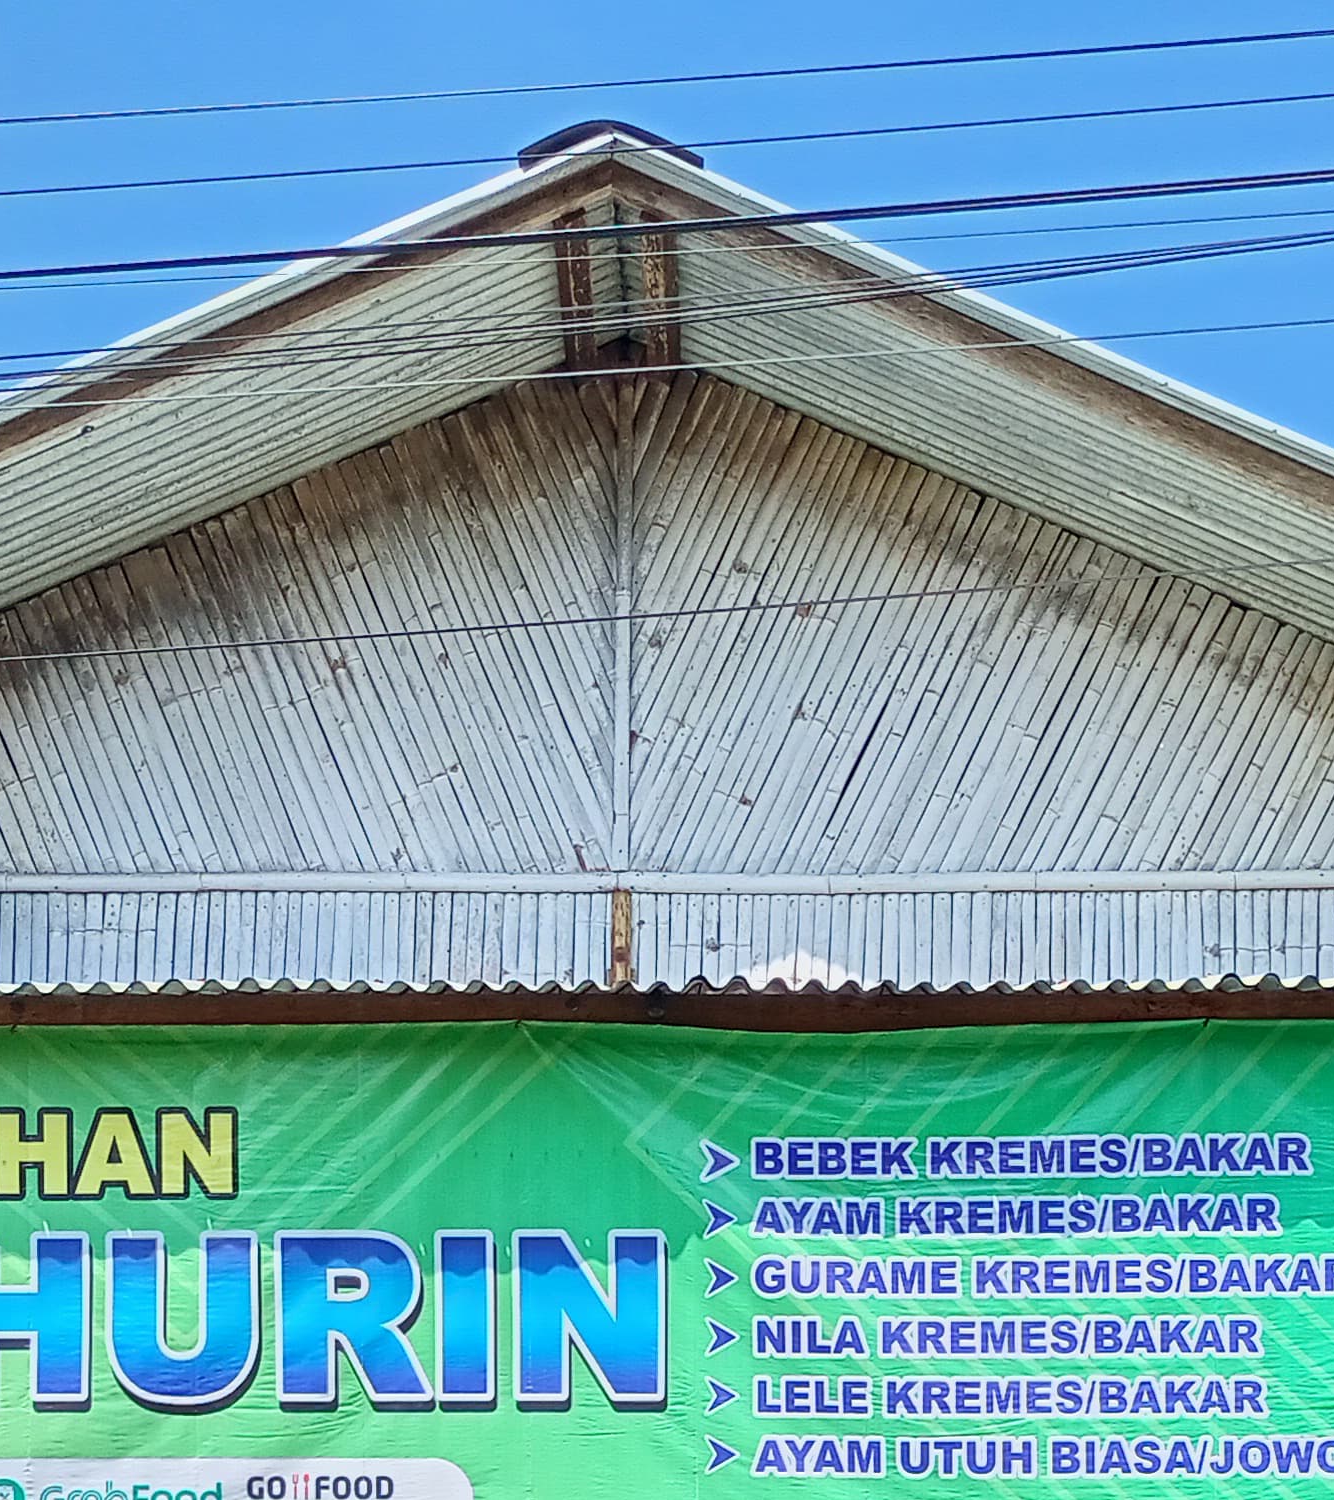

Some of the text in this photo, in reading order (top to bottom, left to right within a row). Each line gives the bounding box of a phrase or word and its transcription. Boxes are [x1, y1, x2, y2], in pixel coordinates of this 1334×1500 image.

[752, 1135, 1310, 1178] BEBEK KREMES/BAKAR
[752, 1196, 1280, 1236] AYAM KREMES/BAKAR
[752, 1258, 960, 1296] GURAME
[754, 1318, 1261, 1356] NILA KREMES/BAKAR
[754, 1378, 1267, 1416] LELE KREMES/BAKAR
[753, 1438, 884, 1475] AYAM
[899, 1438, 1034, 1476] UTUH
